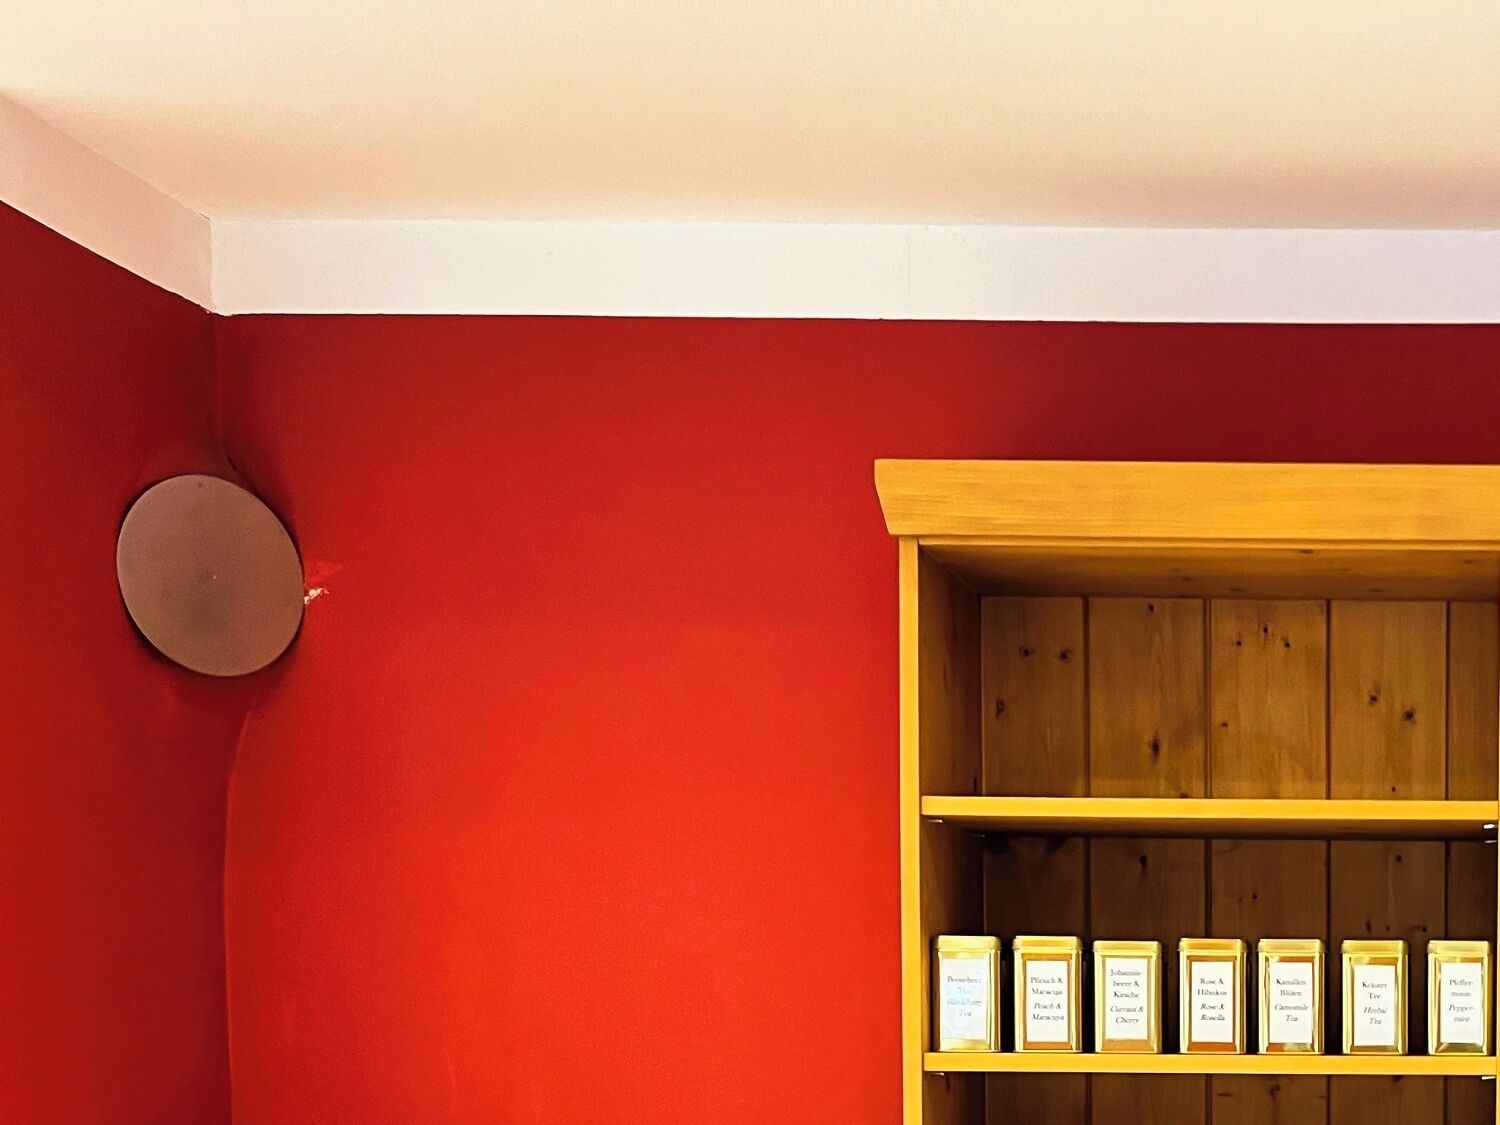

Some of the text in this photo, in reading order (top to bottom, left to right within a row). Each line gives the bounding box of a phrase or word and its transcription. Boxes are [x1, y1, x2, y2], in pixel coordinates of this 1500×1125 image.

[1363, 1006, 1387, 1014] Herbal
[1115, 1016, 1139, 1024] Cherry
[1369, 1017, 1382, 1025] Tea
